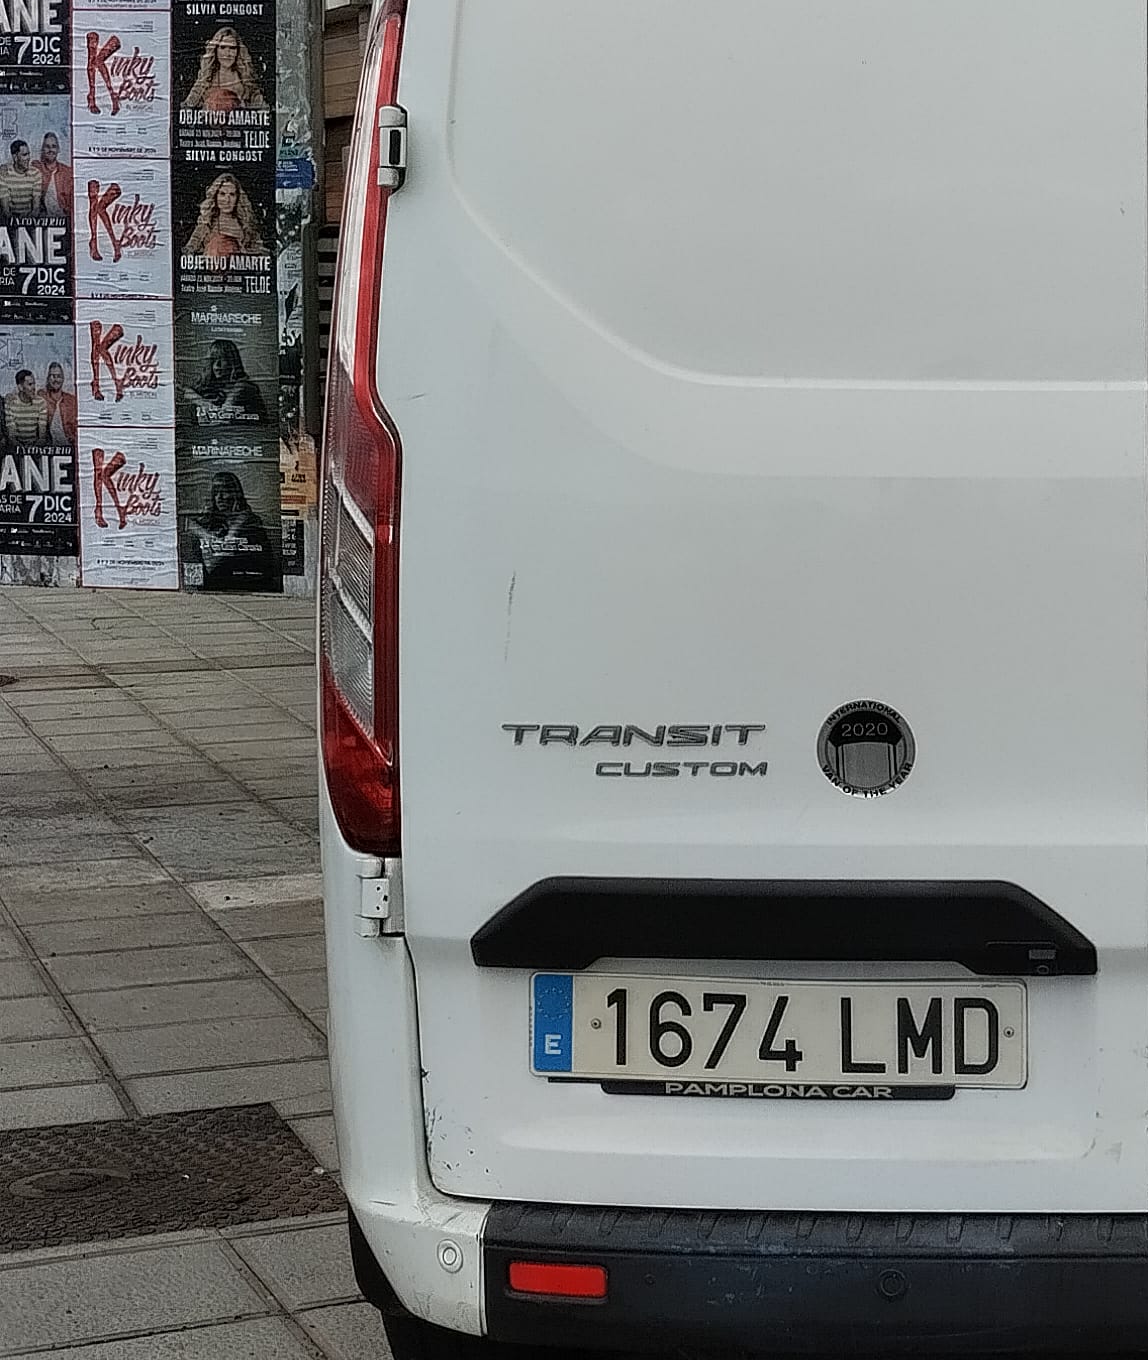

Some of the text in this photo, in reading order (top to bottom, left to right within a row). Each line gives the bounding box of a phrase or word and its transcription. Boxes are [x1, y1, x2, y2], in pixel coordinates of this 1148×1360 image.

[186, 3, 264, 16] SILVIA CONGOST
[14, 36, 61, 65] 7 DIC
[32, 54, 61, 65] 2024
[179, 109, 270, 126] OBJETIVO AMARTE
[243, 130, 270, 148] TELDE
[185, 150, 263, 162] SILVIA CONGOST
[180, 254, 271, 271] OBJETIVO AMARTE
[19, 267, 65, 295] 7 DIC
[37, 285, 66, 296] 2024
[244, 276, 271, 294] TELDE
[90, 320, 159, 403] Kinky
[121, 366, 165, 390] Boots
[0, 454, 73, 493] ANE
[92, 448, 161, 530] Kinky
[10, 494, 23, 504] DE
[126, 494, 170, 517] Boots
[26, 495, 72, 523] 7 DIC
[44, 512, 72, 523] 2024
[826, 700, 902, 726] INTERNATIONAL
[501, 723, 766, 748] TRANSIT
[841, 723, 888, 737] 2020
[595, 761, 768, 777] CUSTOM
[822, 762, 913, 798] VAN OF THE YEAR
[607, 988, 999, 1074] 1674 LMD
[544, 1034, 561, 1055] E
[665, 1082, 894, 1098] PAMPLONA CAR
